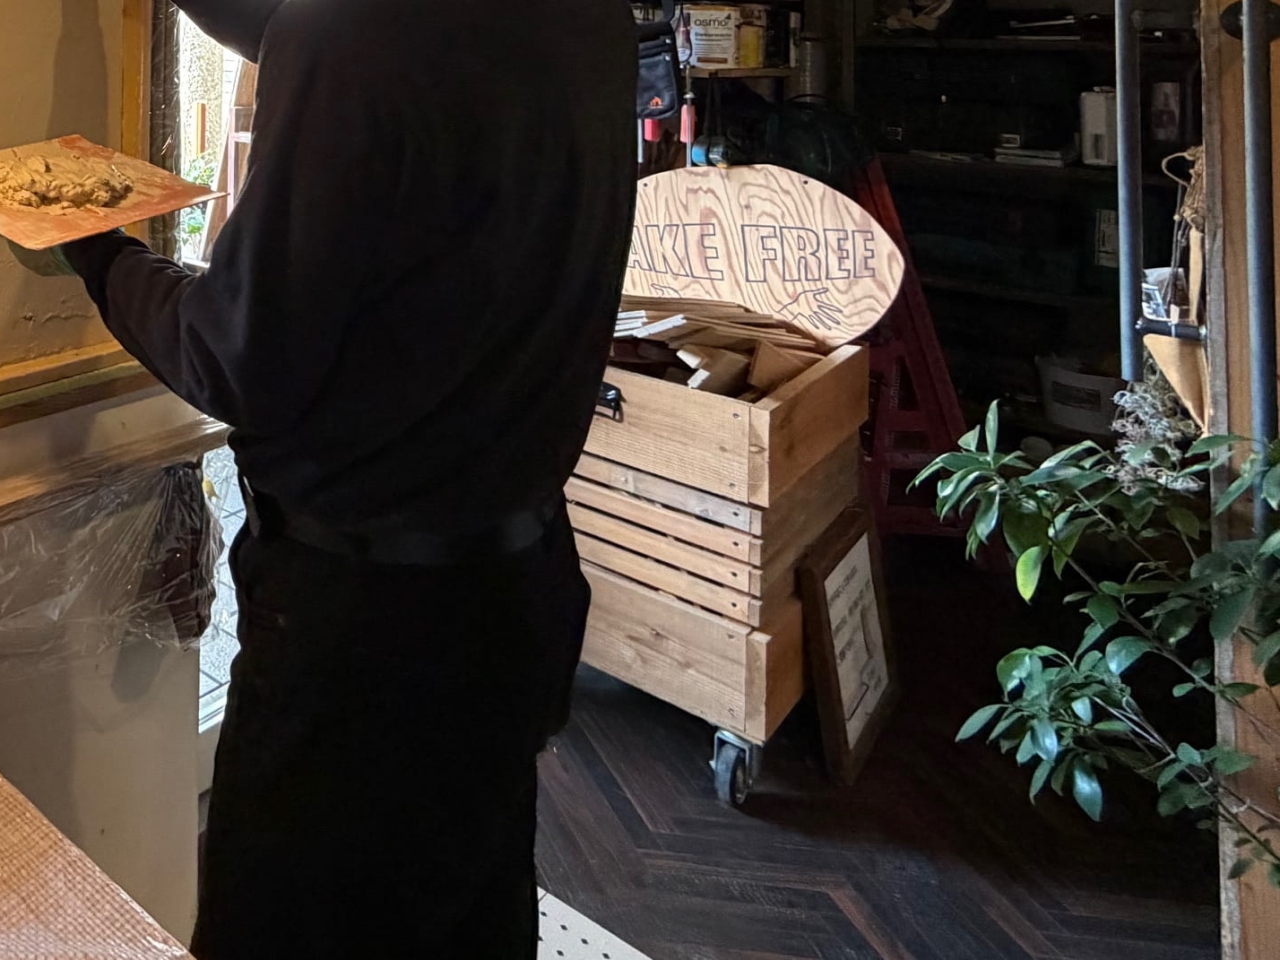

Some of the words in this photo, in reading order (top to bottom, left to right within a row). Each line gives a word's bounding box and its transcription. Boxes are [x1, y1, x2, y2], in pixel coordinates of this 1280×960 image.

[693, 18, 729, 27] osmo
[626, 223, 724, 282] AKE
[740, 223, 875, 284] FREE
